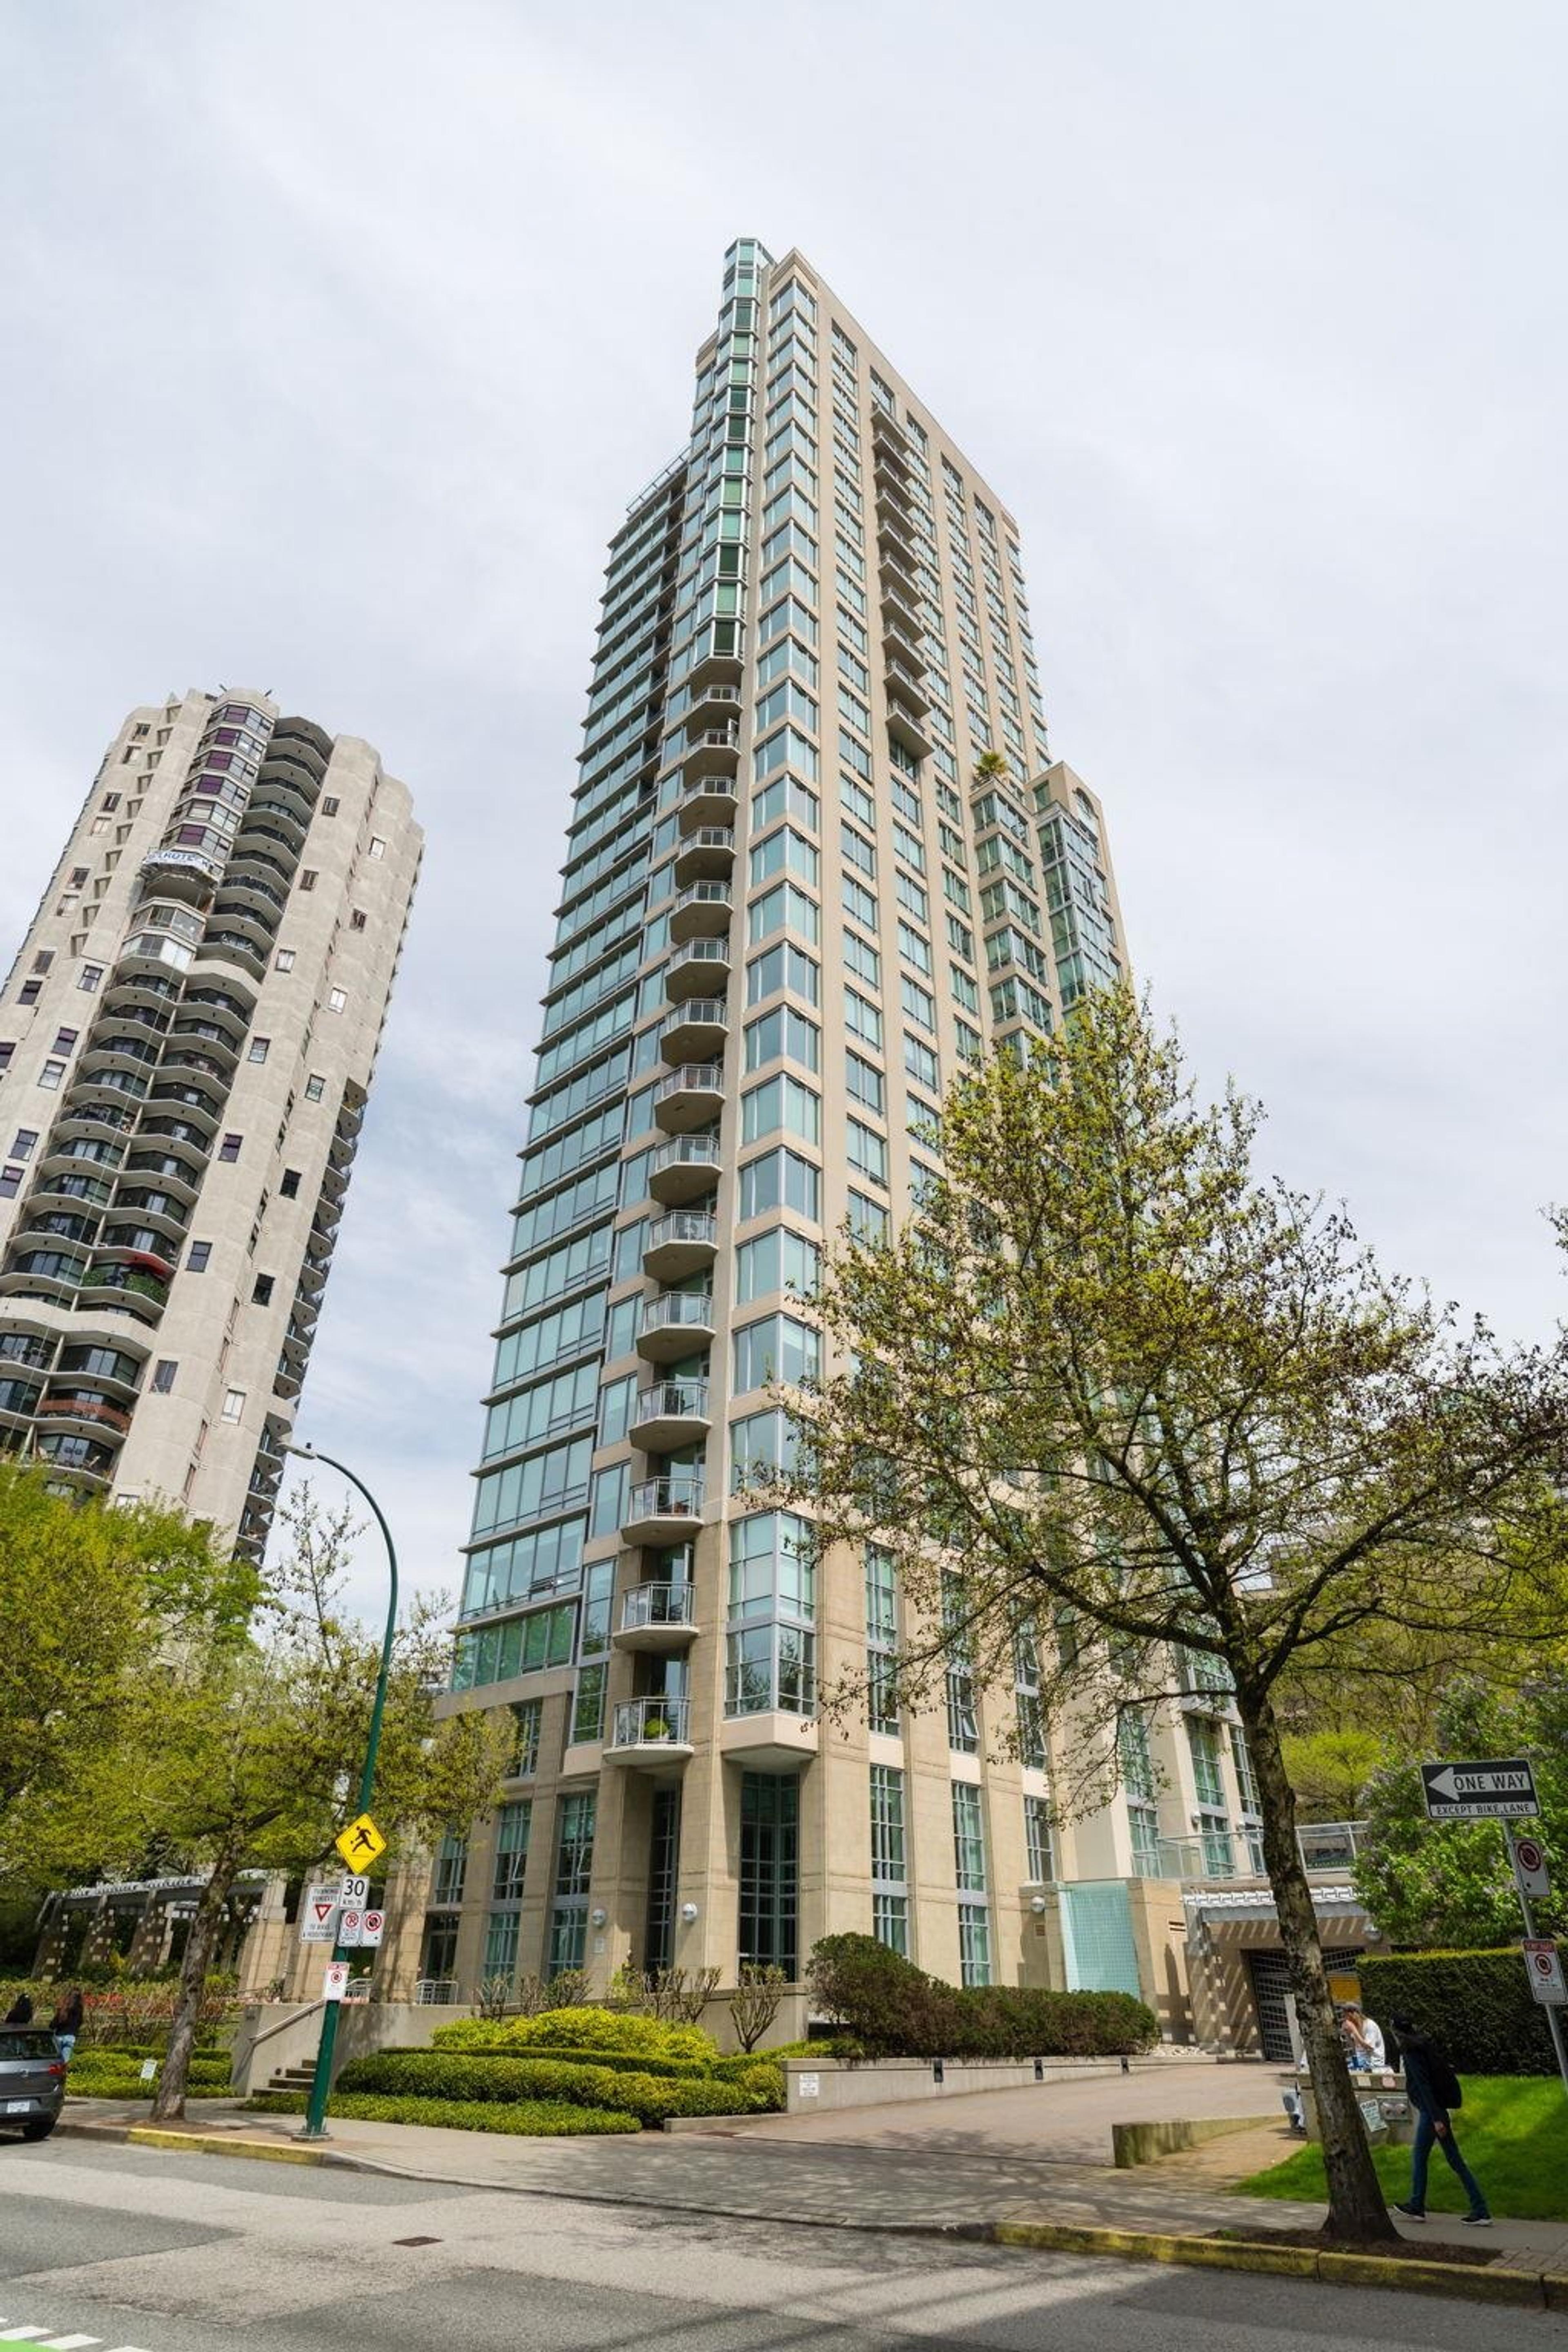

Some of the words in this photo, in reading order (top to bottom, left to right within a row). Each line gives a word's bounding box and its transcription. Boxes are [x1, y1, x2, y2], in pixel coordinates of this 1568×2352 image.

[1454, 1776, 1486, 1791] ONE
[1492, 1774, 1524, 1789] WAY
[1436, 1805, 1472, 1815] EXCEPT
[1476, 1804, 1498, 1814] BIKE
[1503, 1804, 1530, 1813] LANE
[344, 1879, 365, 1896] 30
